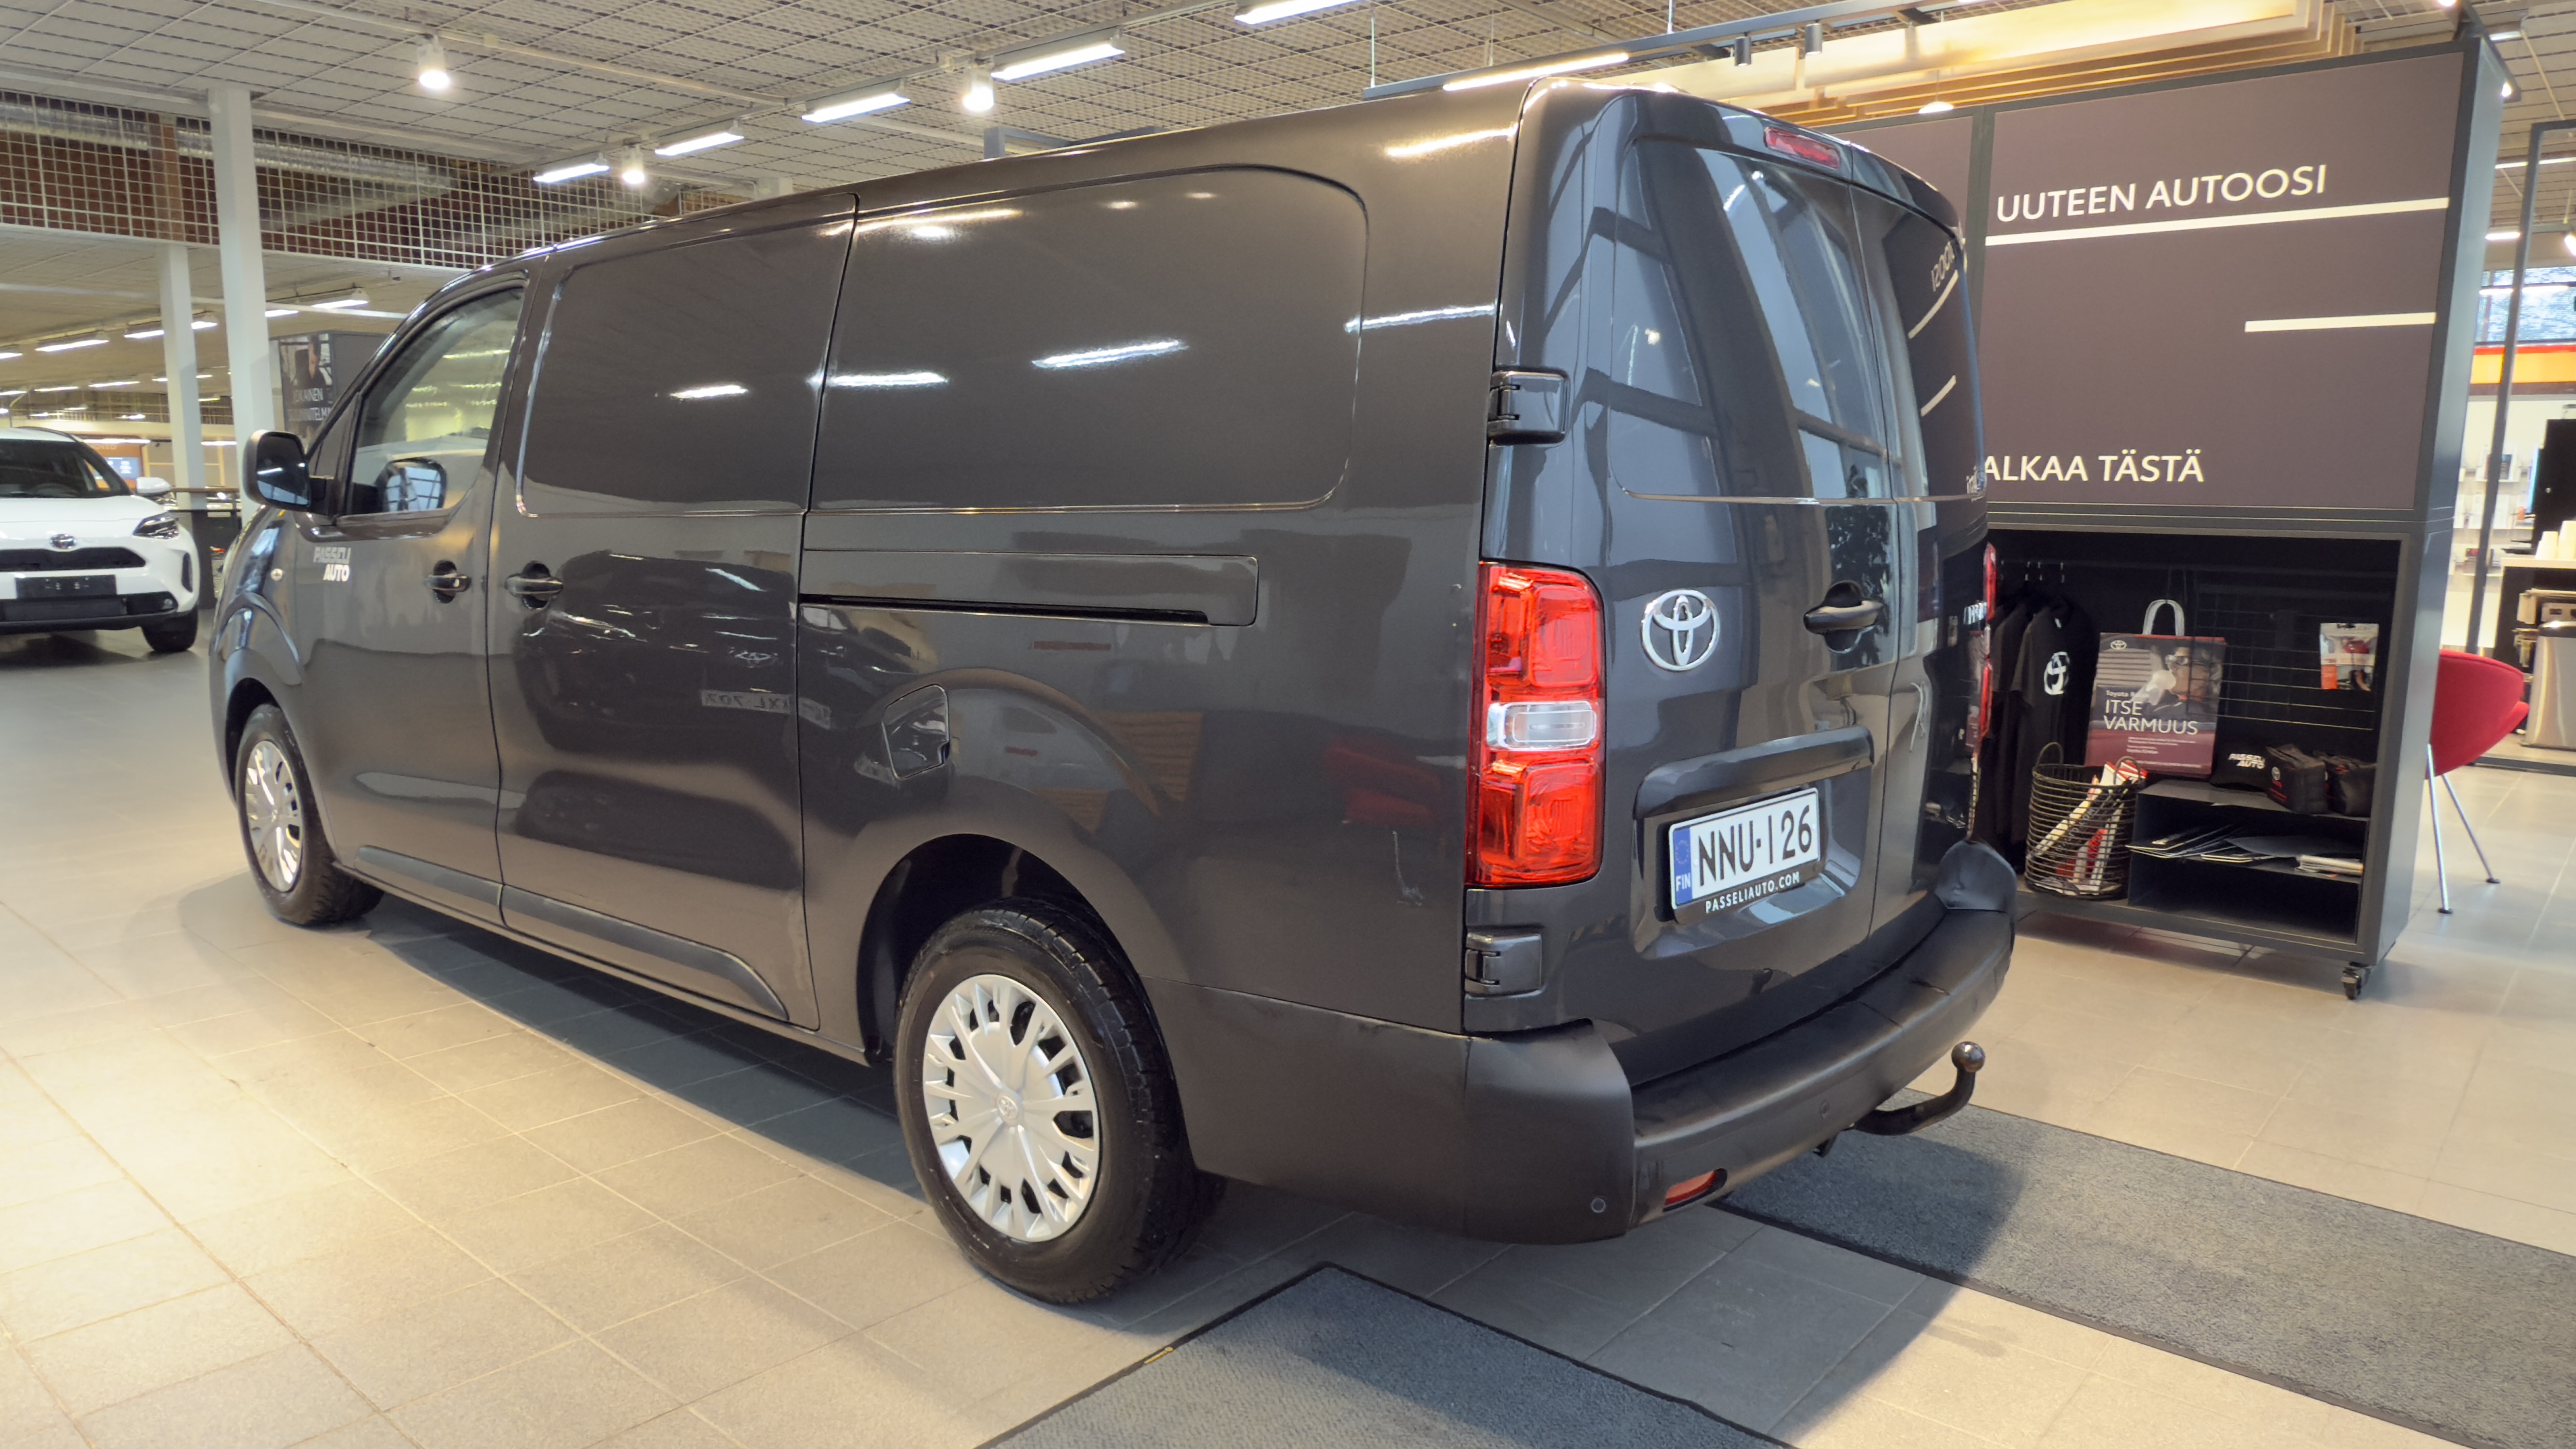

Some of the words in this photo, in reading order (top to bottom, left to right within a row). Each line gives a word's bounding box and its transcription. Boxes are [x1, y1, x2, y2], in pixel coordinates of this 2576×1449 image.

[1997, 183, 2136, 222] UUTEEN
[2146, 165, 2326, 209] AUTOOSI
[1985, 456, 2089, 481] ALKAA
[2098, 449, 2204, 482] TÄSTÄ
[313, 547, 351, 564] PASSELI
[323, 564, 350, 582] AUTO
[2105, 699, 2143, 715] ITSE
[2104, 715, 2198, 735] VARMUUS
[2236, 760, 2265, 769] AUTO
[1698, 805, 1812, 887] NNU-126
[1675, 872, 1691, 892] FIN
[1705, 871, 1800, 914] PASSELIAUTO.COM
